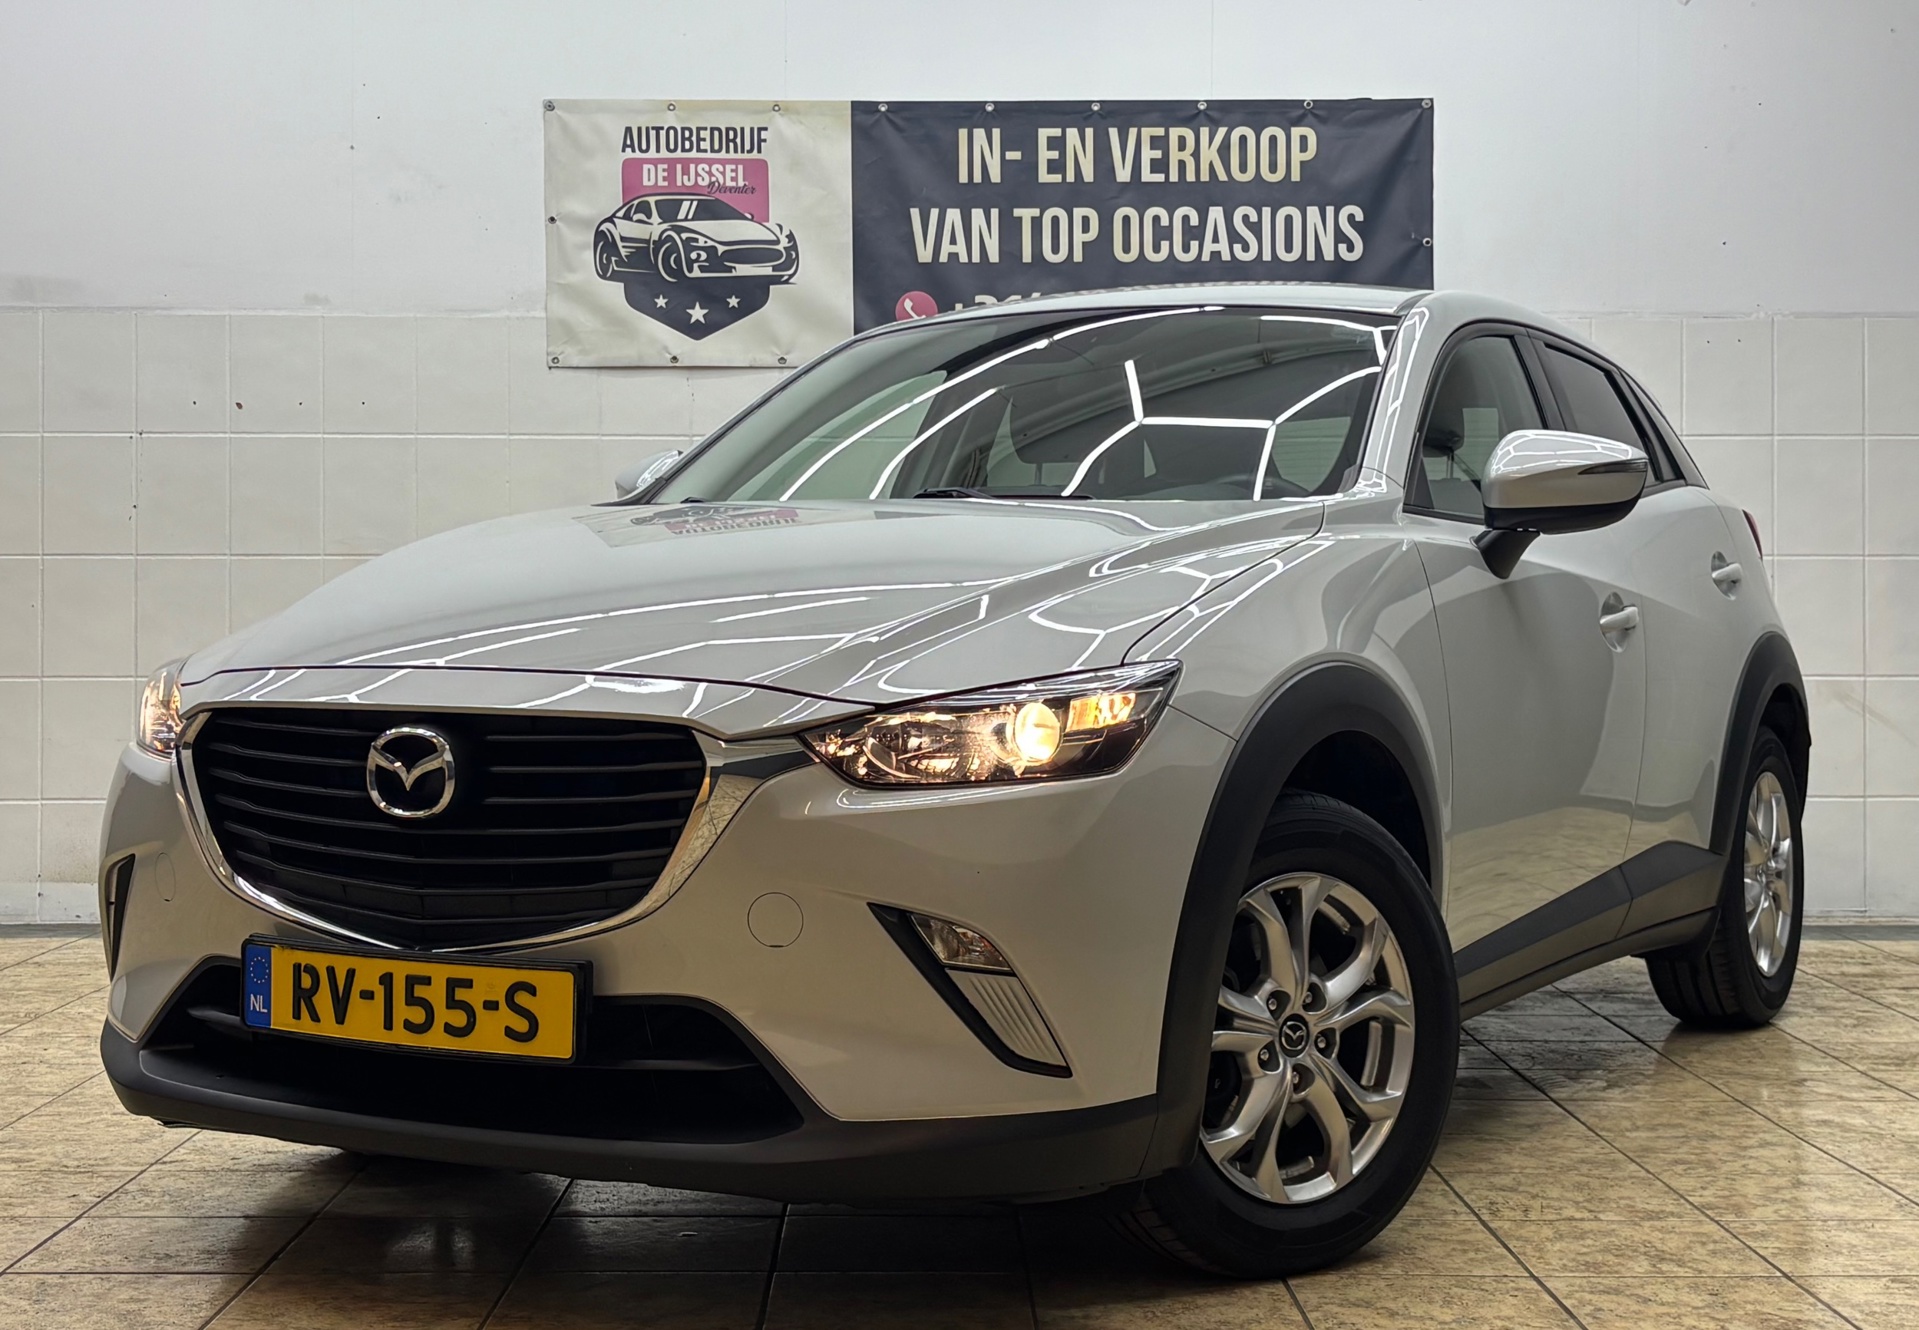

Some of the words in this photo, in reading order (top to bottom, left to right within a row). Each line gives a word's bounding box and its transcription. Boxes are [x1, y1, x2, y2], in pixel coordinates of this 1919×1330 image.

[621, 126, 768, 154] AUTOBEDRIJF
[957, 127, 1022, 183] IN-
[1037, 127, 1094, 183] EN
[1108, 126, 1318, 183] VERKOOP
[642, 163, 668, 186] DE
[676, 163, 749, 187] IJSSEL
[707, 181, 756, 195] Deventer
[909, 207, 999, 264] VAN
[1013, 207, 1099, 263] TOP
[1113, 205, 1365, 263] OCCASIONS
[250, 994, 268, 1013] NL
[292, 962, 540, 1043] RV-155-S
